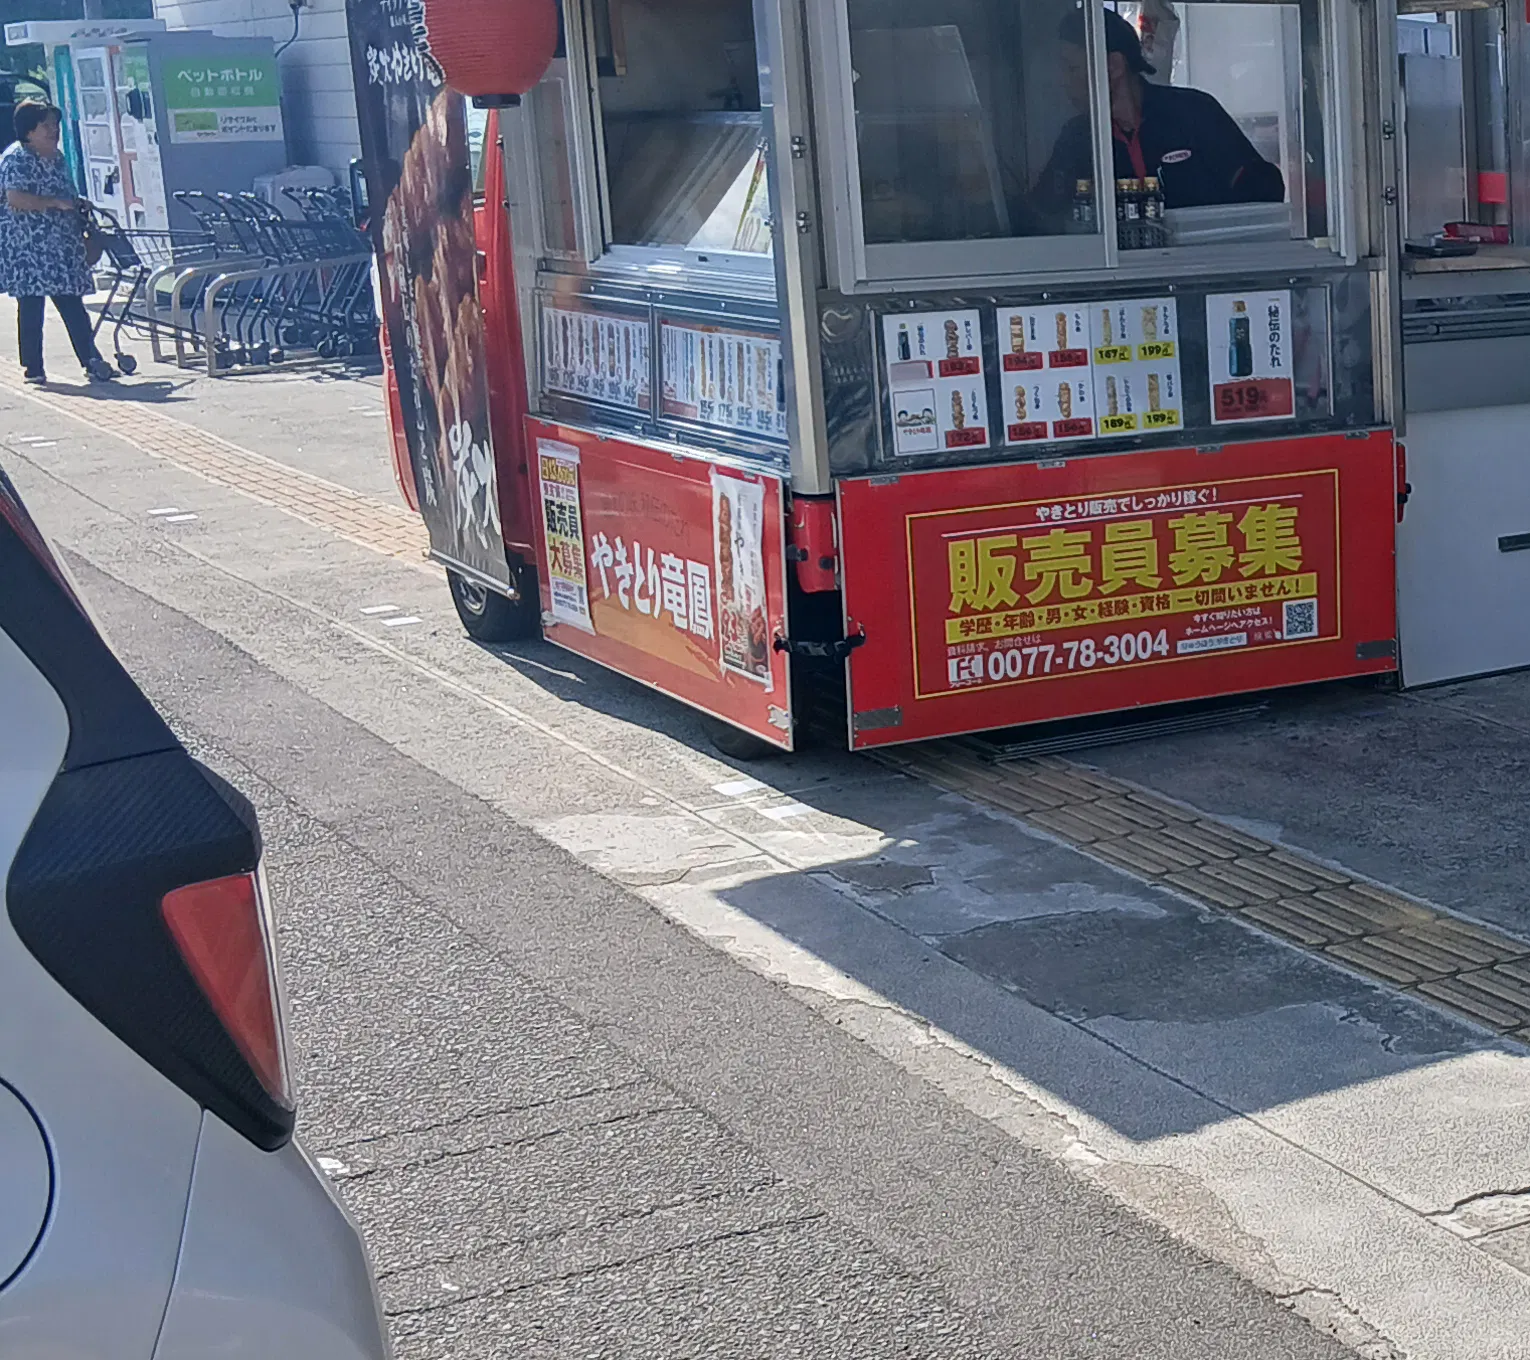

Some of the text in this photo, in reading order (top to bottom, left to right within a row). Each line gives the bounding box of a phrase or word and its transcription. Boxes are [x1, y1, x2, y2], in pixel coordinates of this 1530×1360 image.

[177, 67, 263, 83] ペットボトル
[545, 498, 580, 541] 販売員
[549, 537, 584, 580] 大募集
[948, 503, 1303, 614] 販売員募集
[590, 530, 715, 643] やきとり竜鳳
[1193, 606, 1262, 624] 今すぐ知りたい方は
[988, 627, 1170, 681] 0077-78-3004
